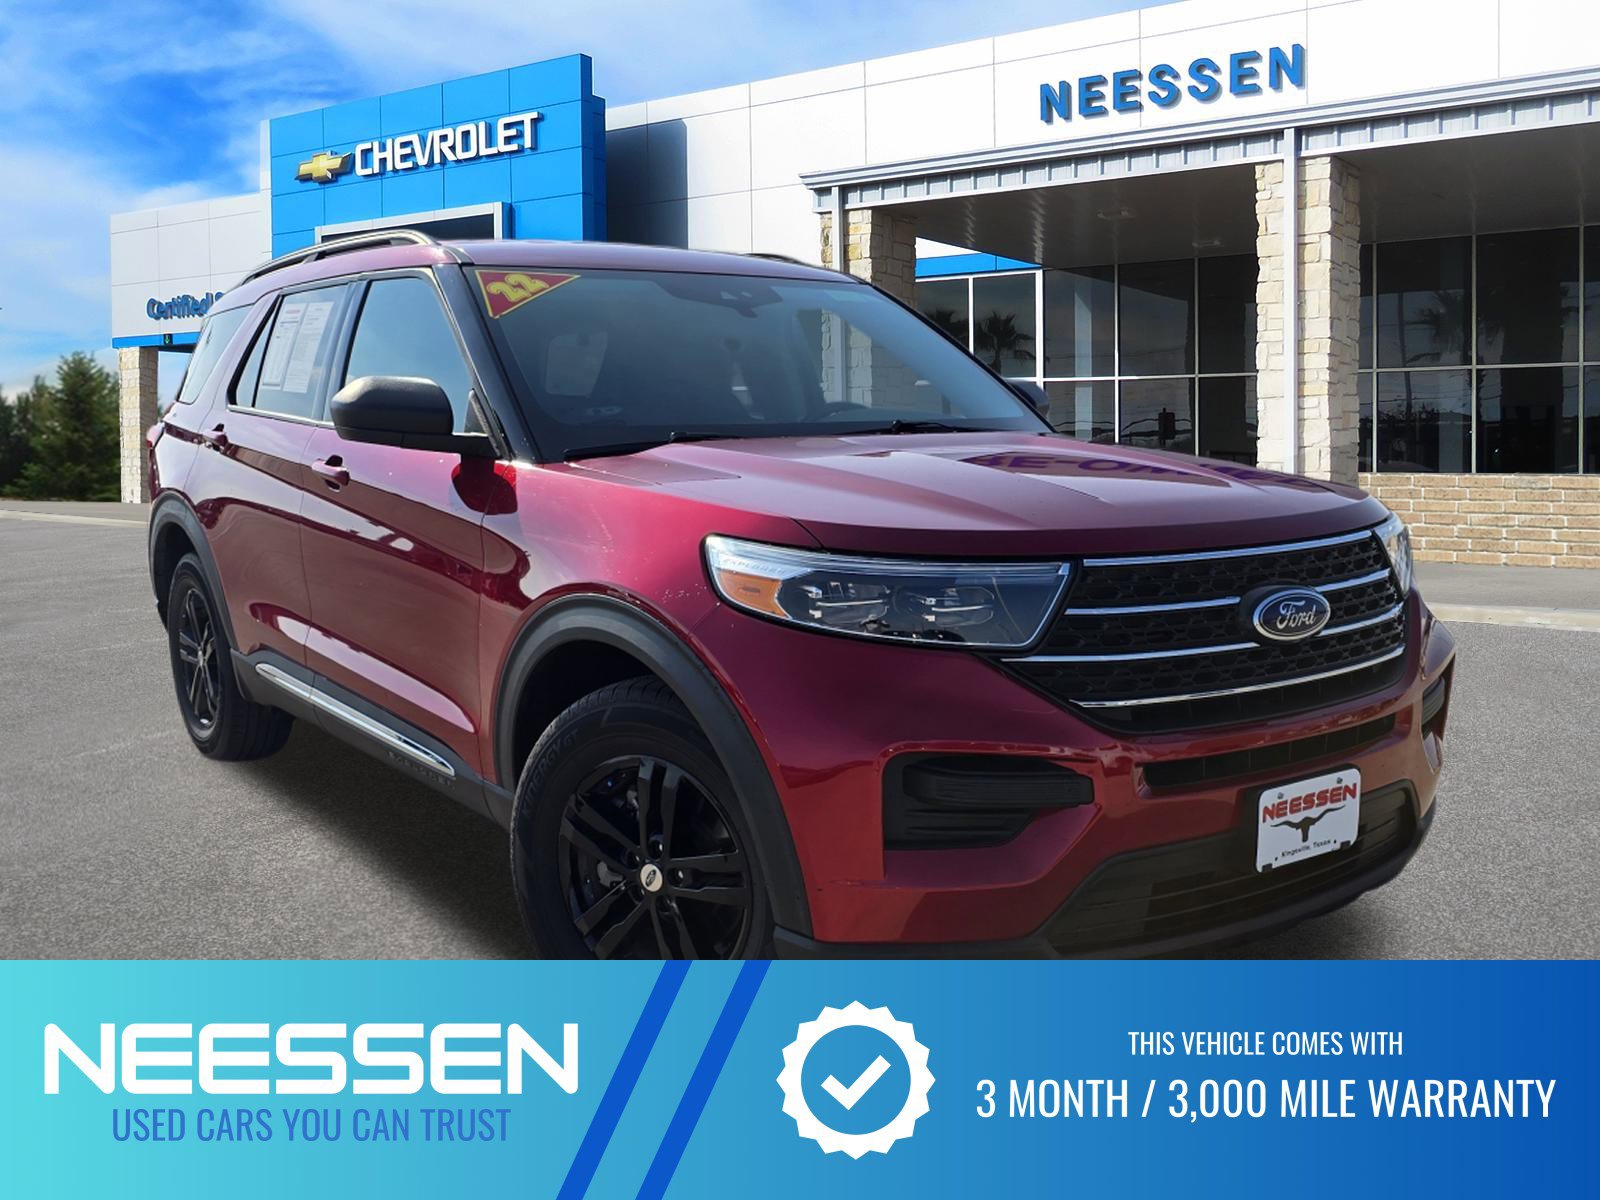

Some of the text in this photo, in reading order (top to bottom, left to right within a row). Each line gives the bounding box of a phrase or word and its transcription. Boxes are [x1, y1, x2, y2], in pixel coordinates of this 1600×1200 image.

[1040, 43, 1305, 124] NEESSEN
[355, 111, 542, 177] CHEVROLET
[487, 273, 549, 302] 22
[146, 292, 214, 320] Certified
[1276, 600, 1317, 630] Ford
[1262, 783, 1357, 823] NEESSEN
